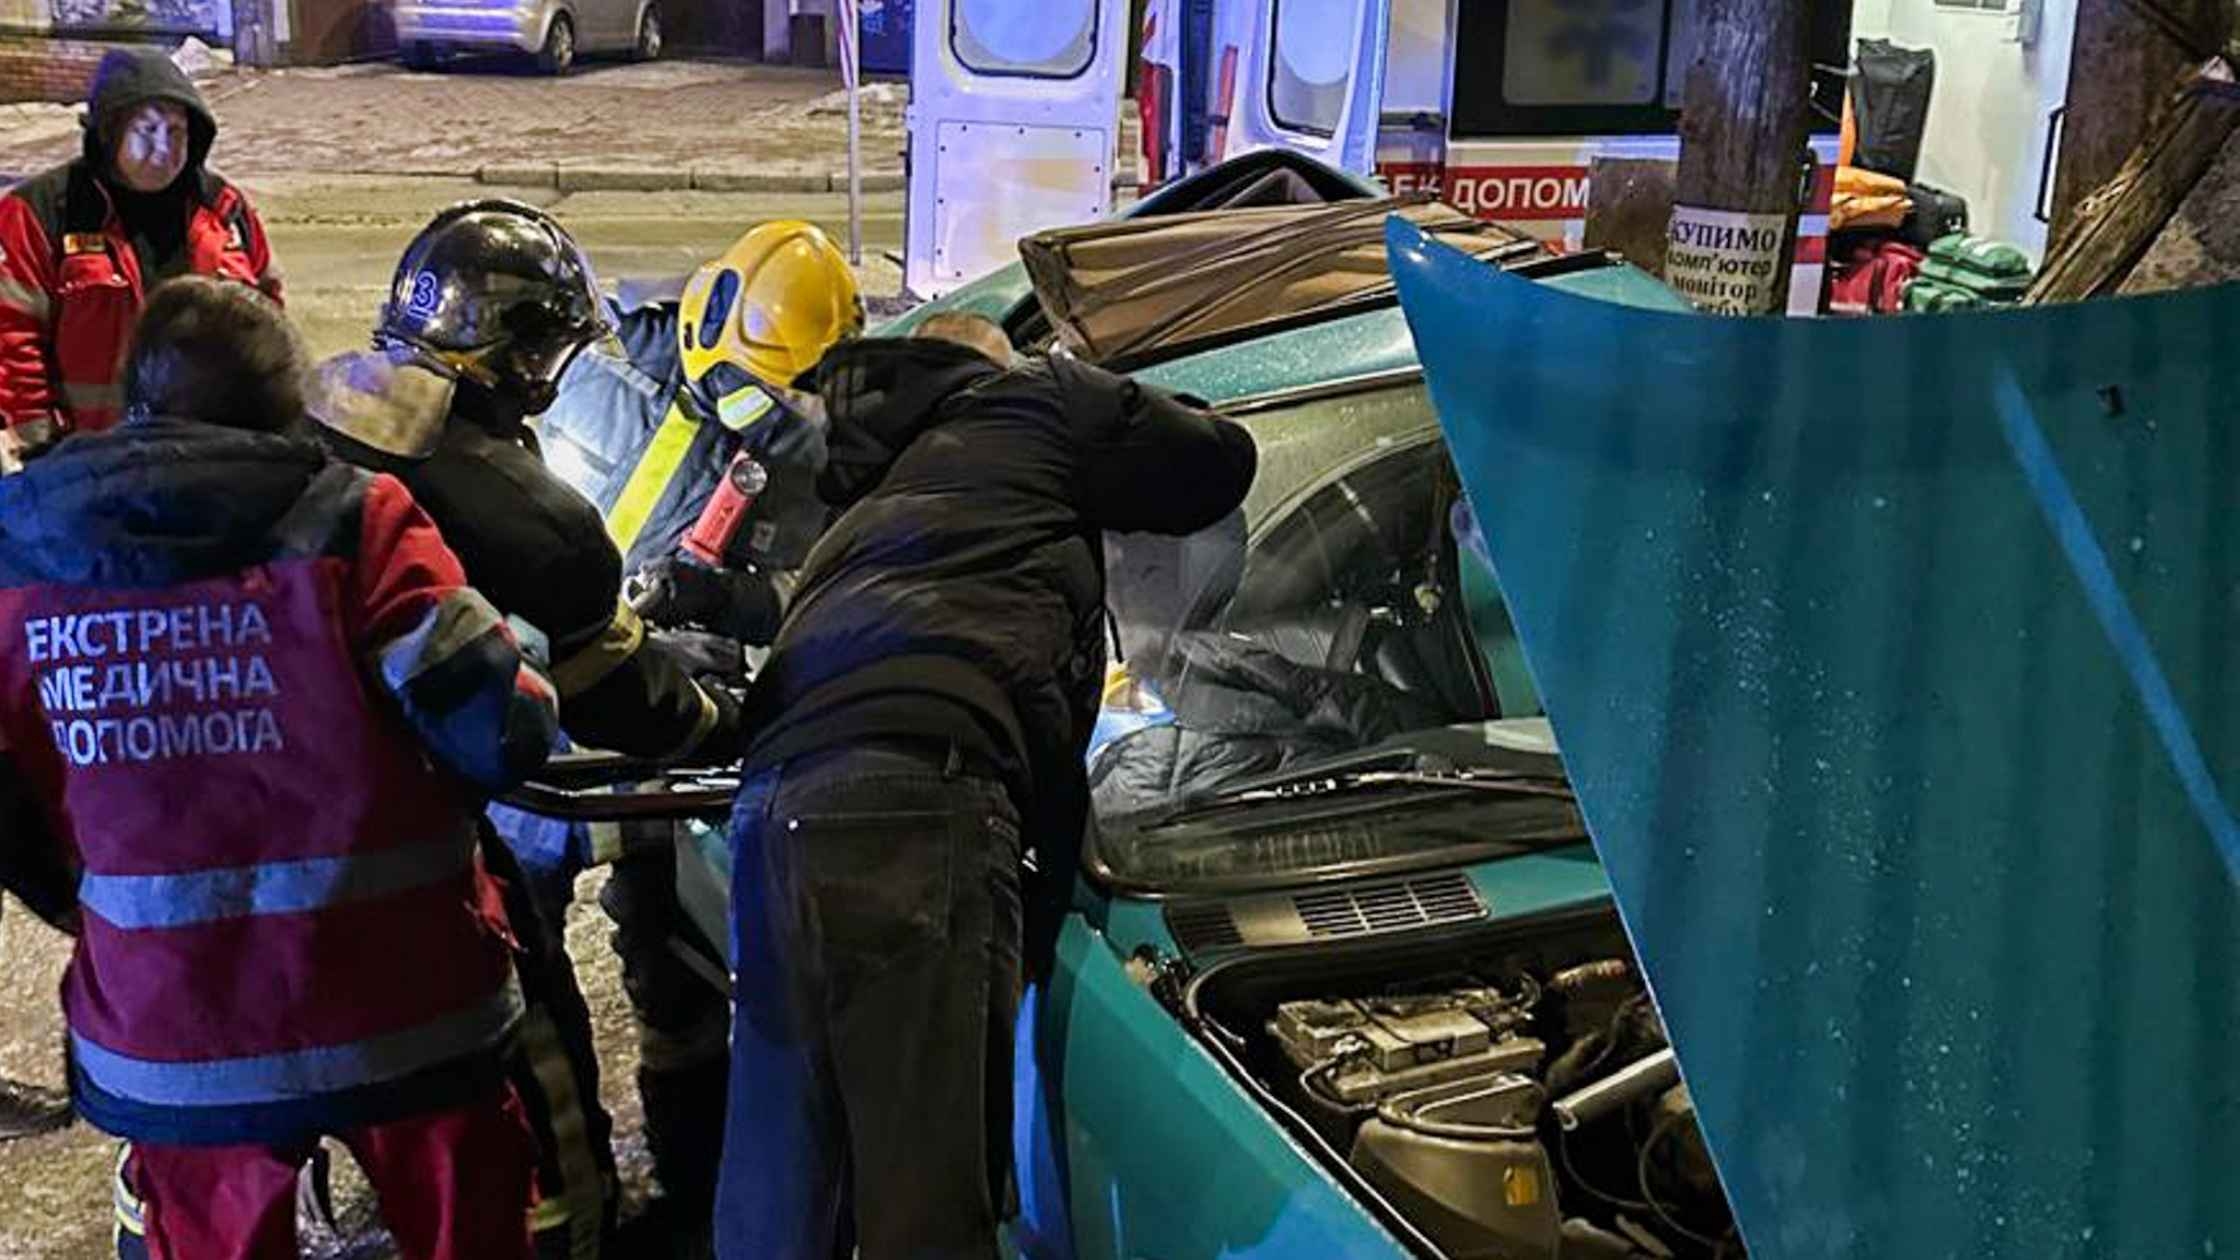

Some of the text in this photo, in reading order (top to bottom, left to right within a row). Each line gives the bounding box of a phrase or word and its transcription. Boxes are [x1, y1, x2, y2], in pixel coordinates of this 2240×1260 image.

[1671, 219, 1777, 252] КУПИМО
[414, 270, 437, 309] 3
[25, 603, 272, 662] ЕКСТРЕНА
[39, 655, 281, 711] МЕДИЧНА
